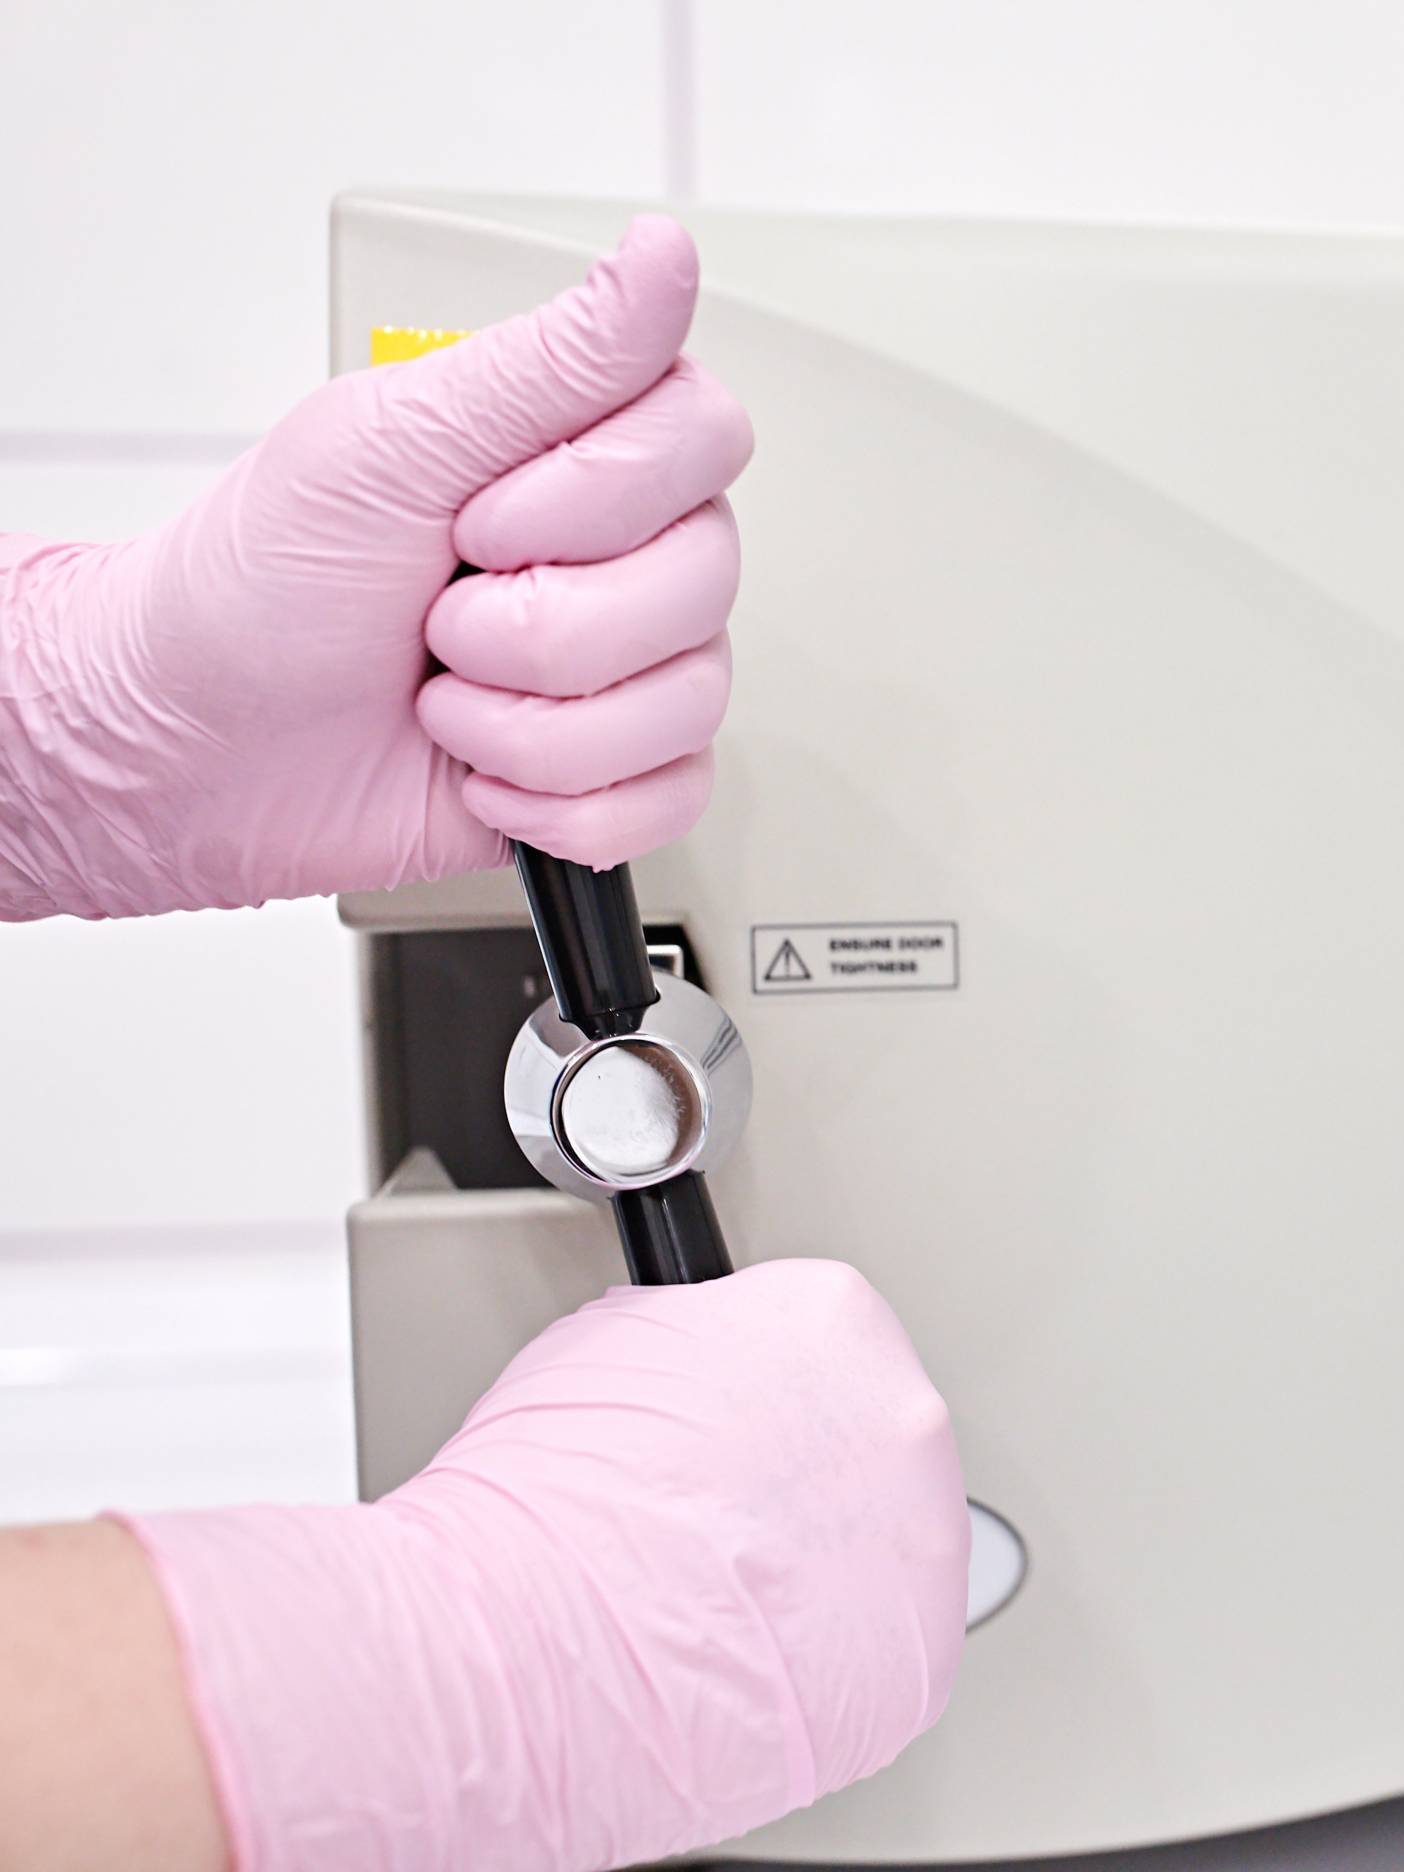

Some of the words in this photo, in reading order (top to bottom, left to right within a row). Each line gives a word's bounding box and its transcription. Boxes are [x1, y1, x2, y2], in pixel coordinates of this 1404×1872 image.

[829, 937, 891, 951] ENSURE
[899, 936, 943, 950] DOOR
[831, 961, 917, 975] TIGHTNESS
